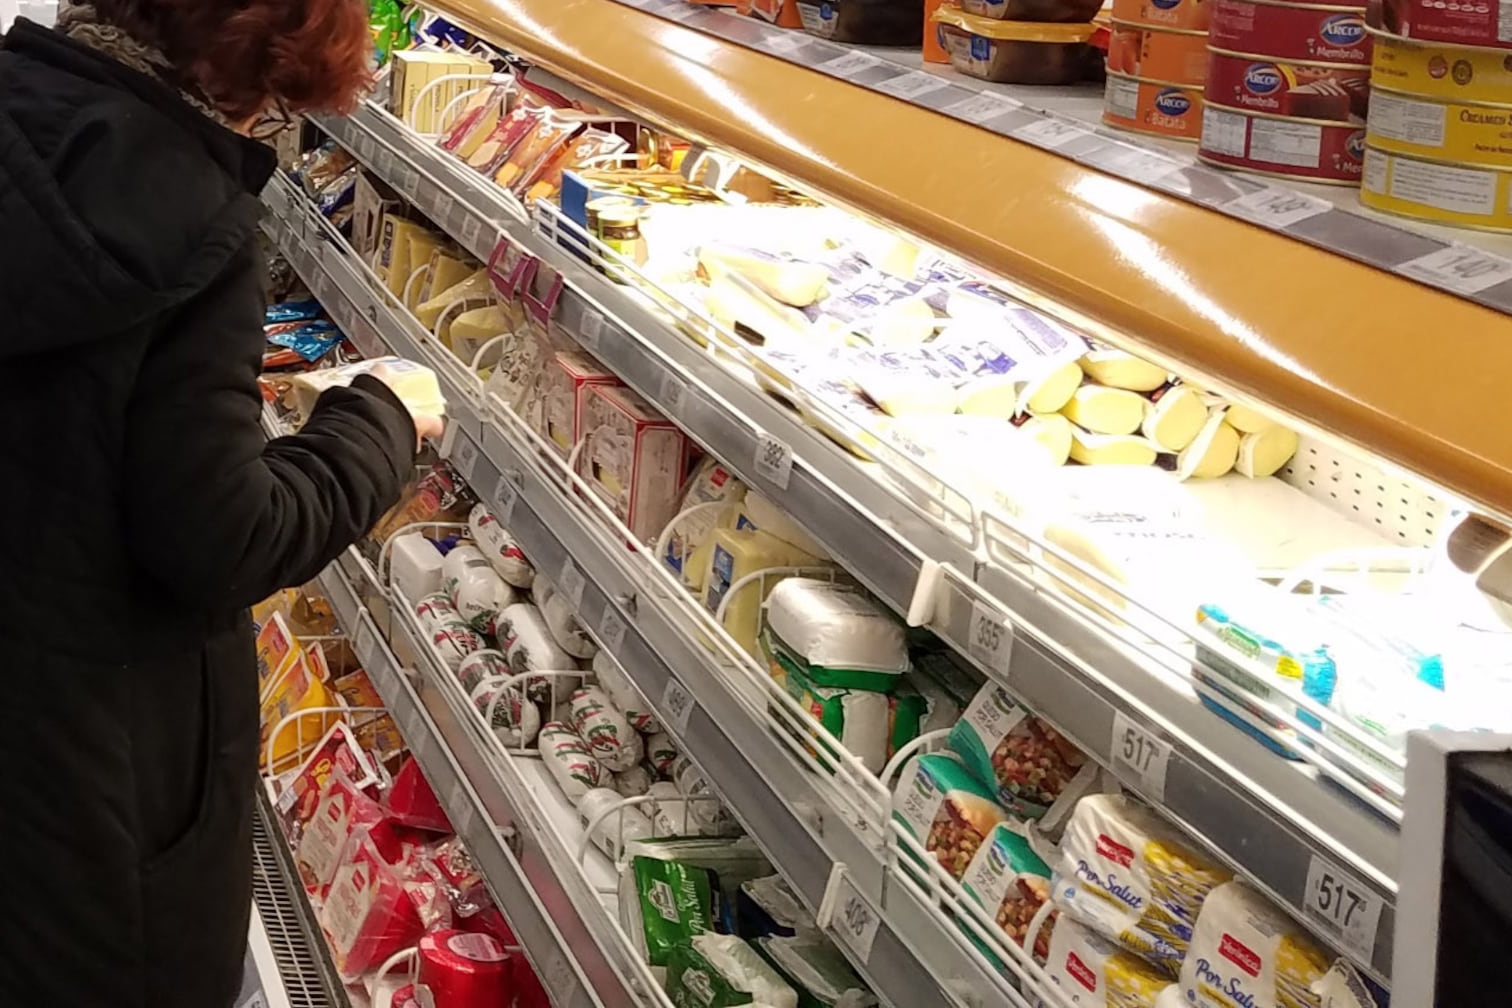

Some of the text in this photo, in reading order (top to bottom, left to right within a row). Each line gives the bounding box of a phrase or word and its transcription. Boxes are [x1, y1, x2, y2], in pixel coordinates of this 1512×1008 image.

[1122, 727, 1154, 772] 517
[1077, 859, 1143, 909] Por Salut
[1317, 873, 1359, 927] 517
[1195, 958, 1222, 988] Por
